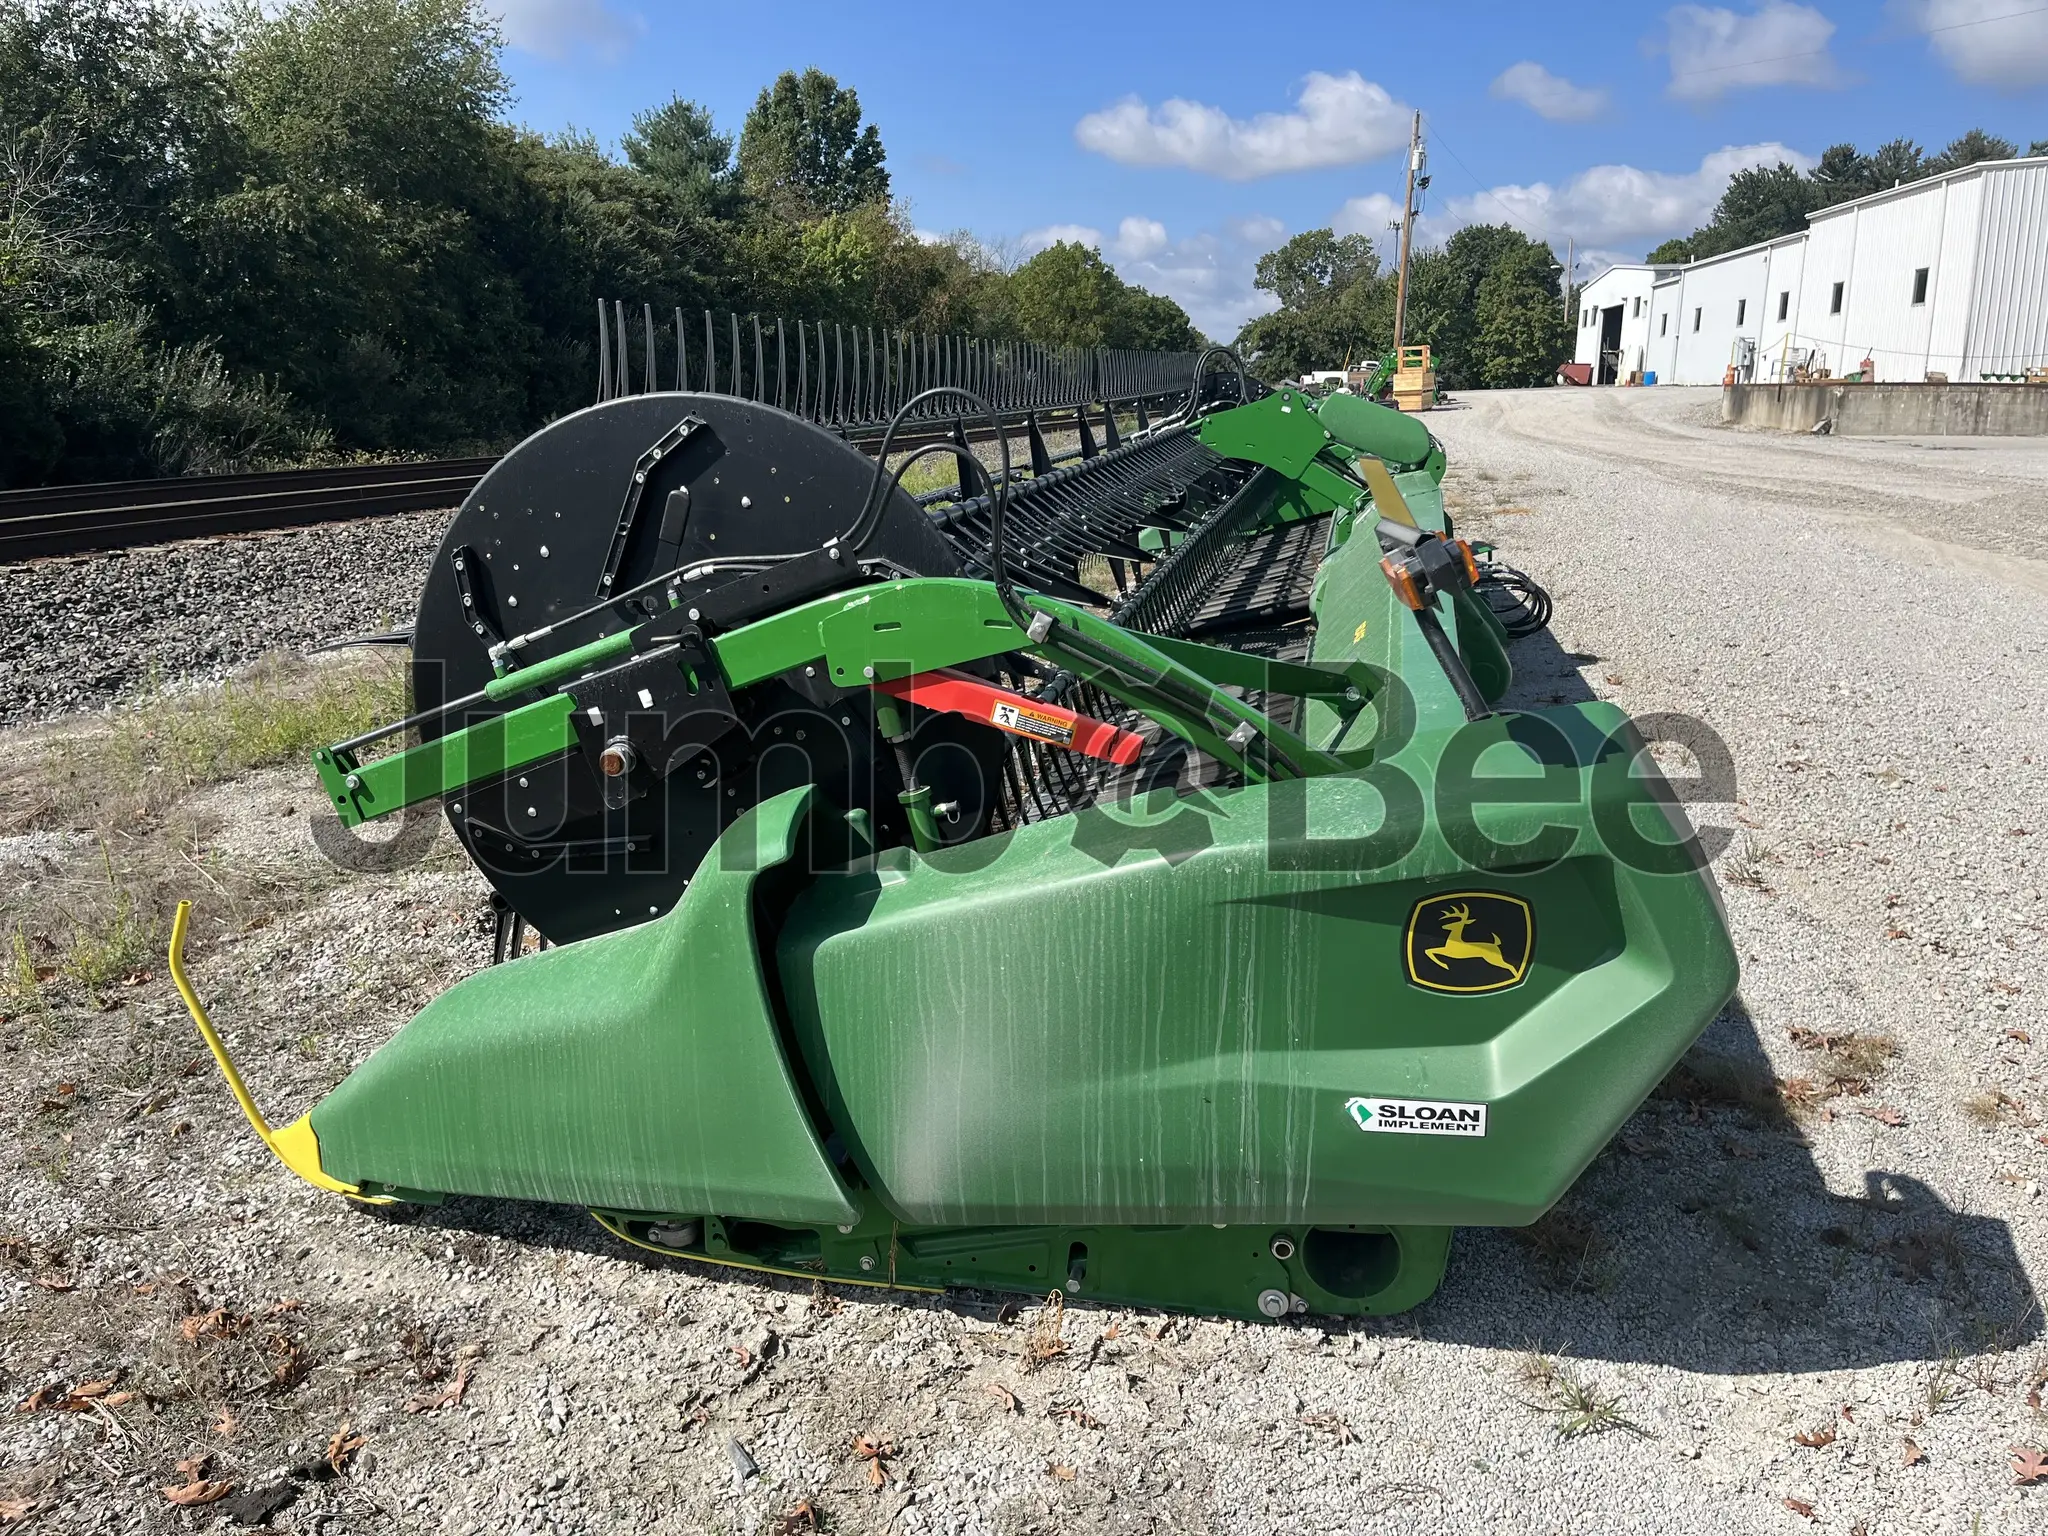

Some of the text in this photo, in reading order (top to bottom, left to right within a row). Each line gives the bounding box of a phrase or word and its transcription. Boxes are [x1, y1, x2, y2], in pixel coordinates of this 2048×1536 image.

[1037, 713, 1068, 728] WARNING
[1378, 1104, 1480, 1122] SLOAN
[1378, 1119, 1480, 1132] IMPLEMENT
